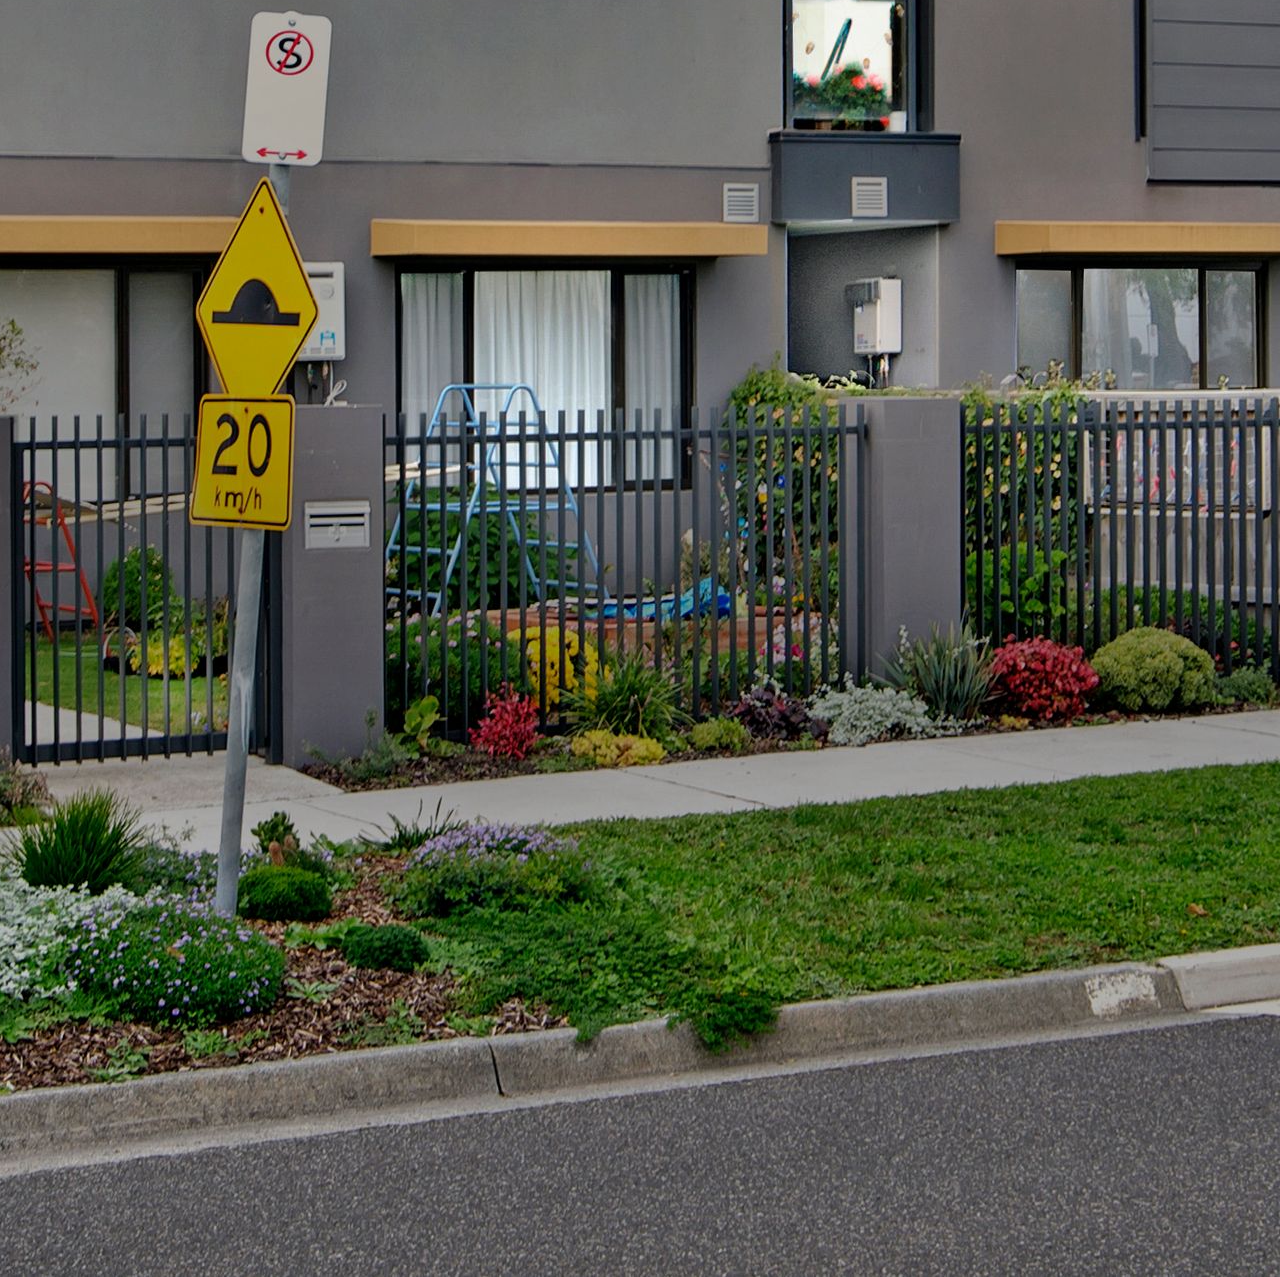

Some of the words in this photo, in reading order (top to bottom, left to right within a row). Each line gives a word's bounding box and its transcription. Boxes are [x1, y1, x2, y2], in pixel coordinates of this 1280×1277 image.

[277, 37, 302, 69] S
[212, 413, 272, 477] 20
[214, 485, 262, 513] km/h
